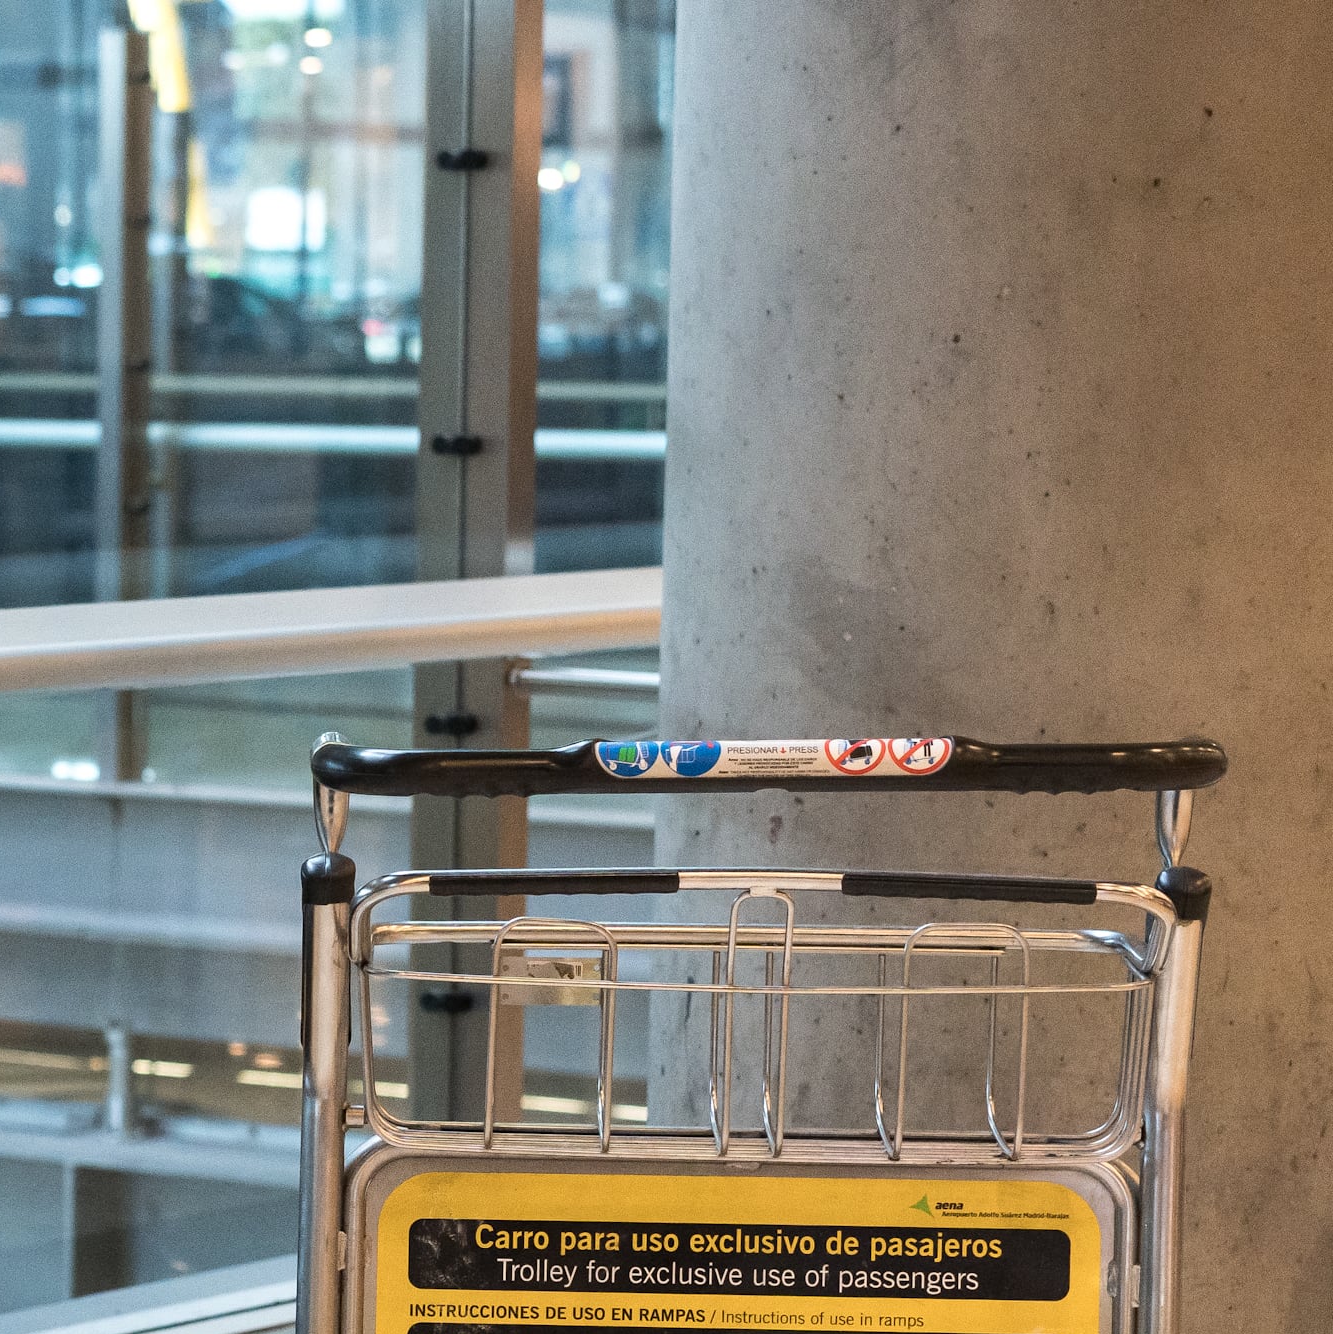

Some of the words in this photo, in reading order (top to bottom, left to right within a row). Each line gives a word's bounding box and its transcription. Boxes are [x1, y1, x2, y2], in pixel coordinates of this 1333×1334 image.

[935, 1202, 964, 1210] aena
[475, 1224, 549, 1250] Carro
[560, 1231, 619, 1256] para
[632, 1233, 679, 1252] uso
[689, 1228, 815, 1255] exclusivo
[826, 1231, 859, 1255] de
[870, 1233, 1002, 1262] pasajeros
[497, 1258, 577, 1288] Trolley
[586, 1260, 620, 1284] for
[629, 1260, 743, 1286] exclusive
[753, 1268, 795, 1287] use
[805, 1264, 829, 1287] of
[839, 1268, 979, 1295] passengers
[410, 1304, 539, 1319] INSTRUCCIONES
[546, 1306, 566, 1320] DE
[573, 1307, 605, 1320] USO
[612, 1308, 632, 1321] EN
[639, 1309, 705, 1323] RAMPAS
[722, 1310, 805, 1325] Instructions
[811, 1312, 824, 1324] of
[830, 1314, 854, 1325] use
[860, 1312, 873, 1326] in
[879, 1316, 924, 1329] ramps
